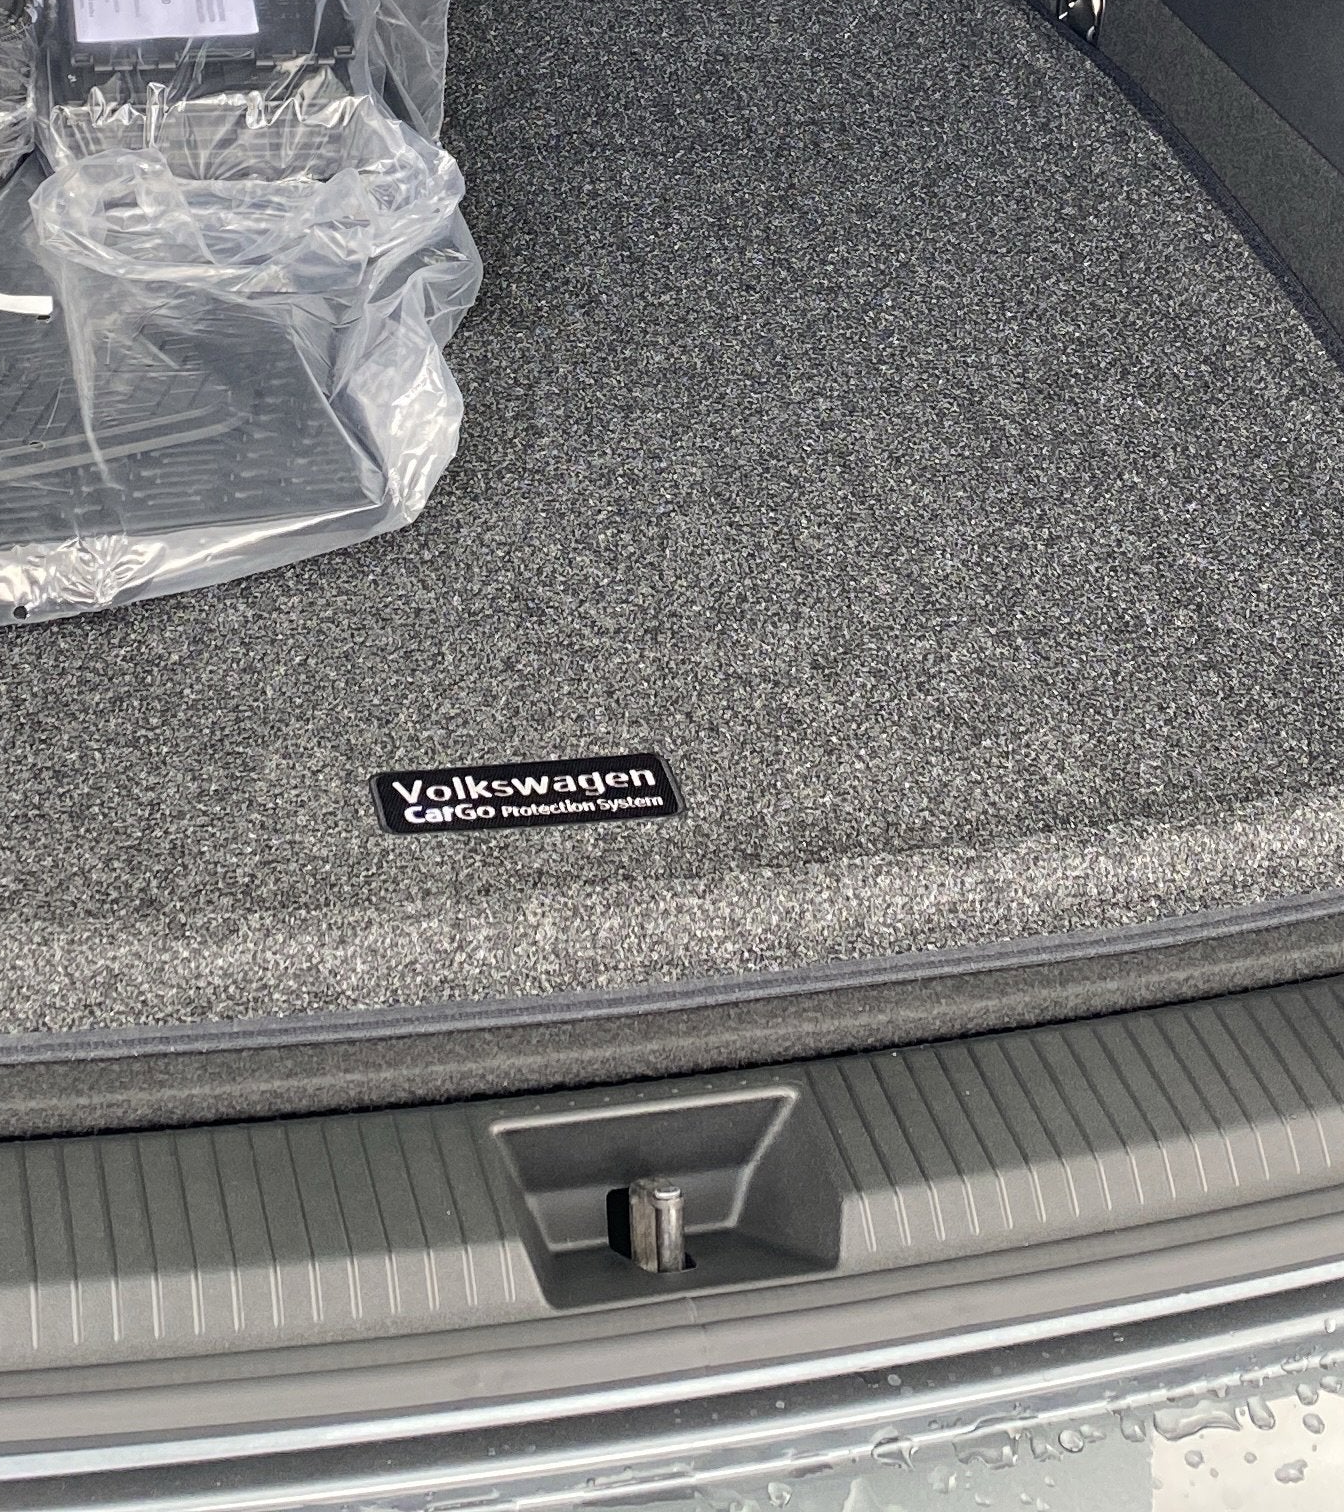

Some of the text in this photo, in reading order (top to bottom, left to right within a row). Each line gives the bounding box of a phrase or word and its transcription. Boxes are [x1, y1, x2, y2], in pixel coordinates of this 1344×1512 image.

[391, 766, 658, 805] Volkswagen
[403, 793, 664, 825] CarGo Protection System
